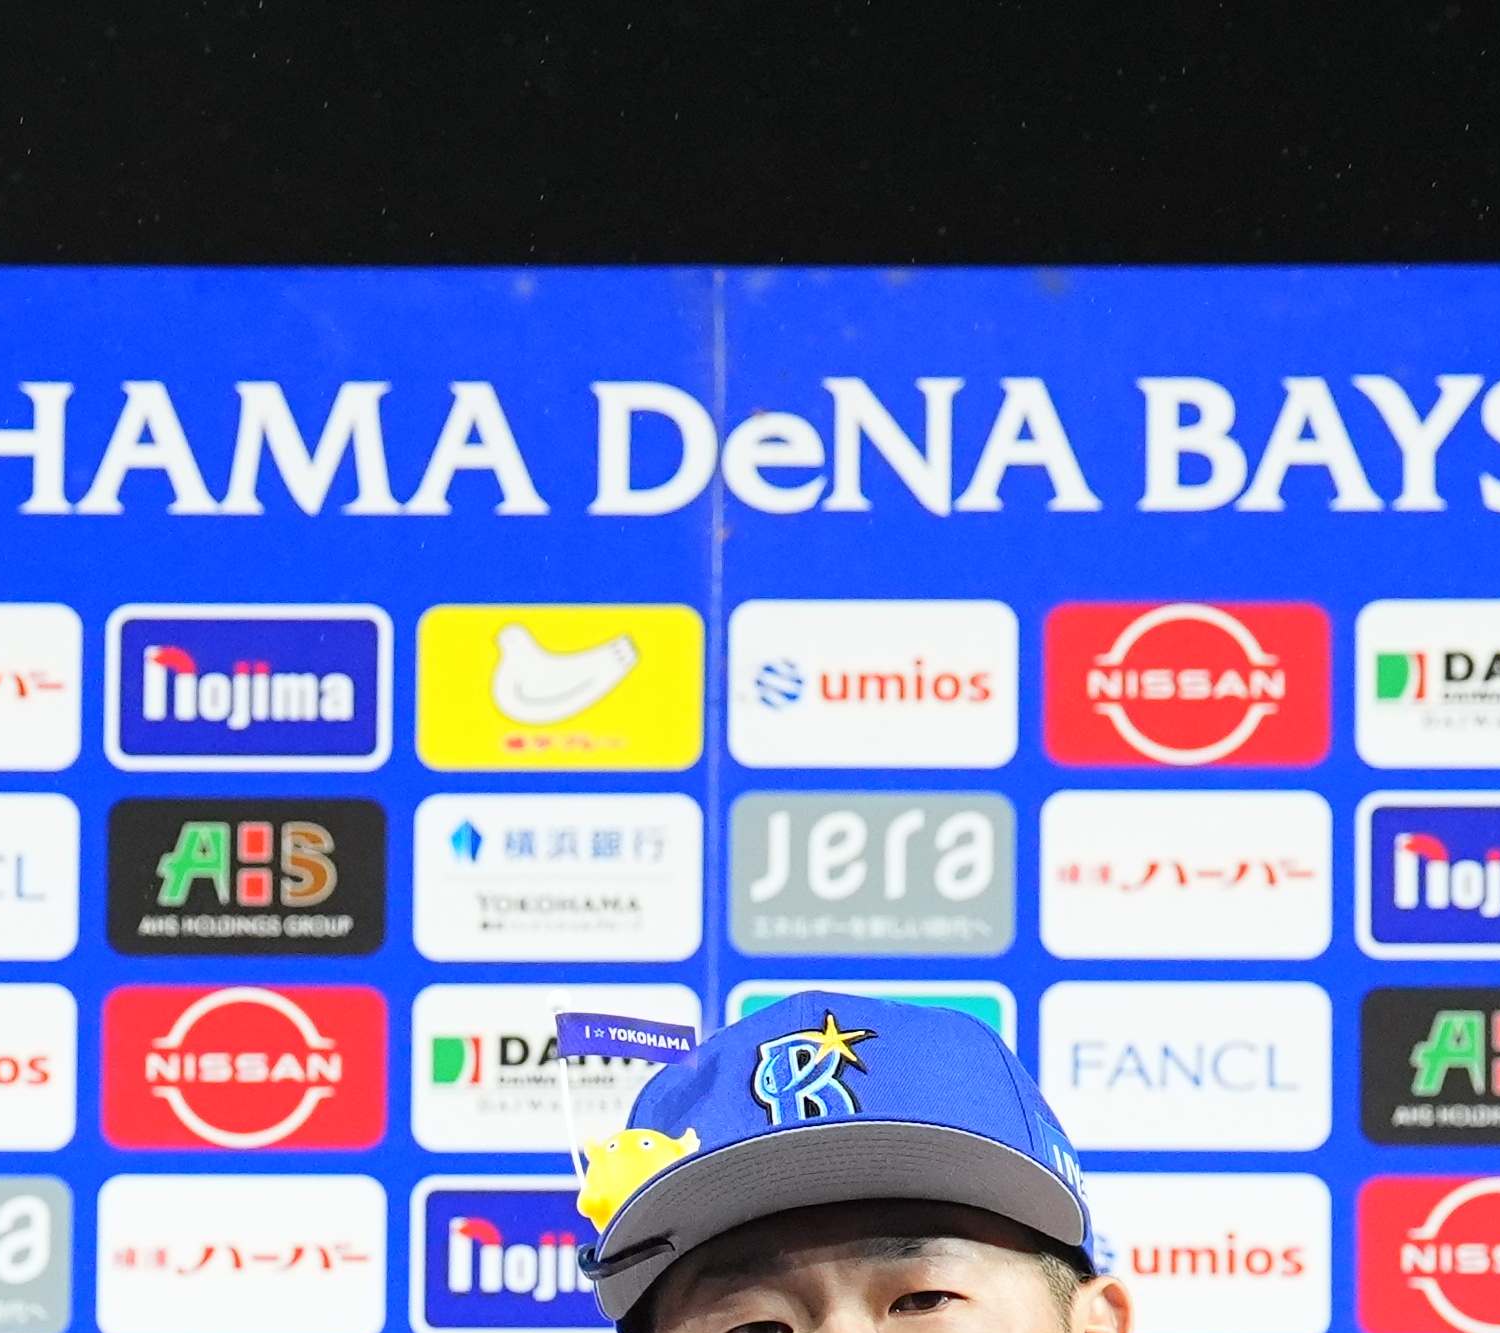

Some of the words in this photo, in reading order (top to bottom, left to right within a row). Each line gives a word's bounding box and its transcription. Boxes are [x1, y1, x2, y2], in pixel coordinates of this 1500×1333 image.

[591, 379, 1098, 514] DeNA
[821, 660, 991, 702] umios
[1087, 669, 1285, 699] NISSAN
[503, 828, 663, 860] 横浜銀行
[284, 915, 353, 937] GROUP
[585, 1025, 591, 1039] I
[607, 1027, 690, 1051] YOKOHAMA
[146, 1053, 342, 1082] NISSAN
[1069, 1041, 1296, 1091] FANCL
